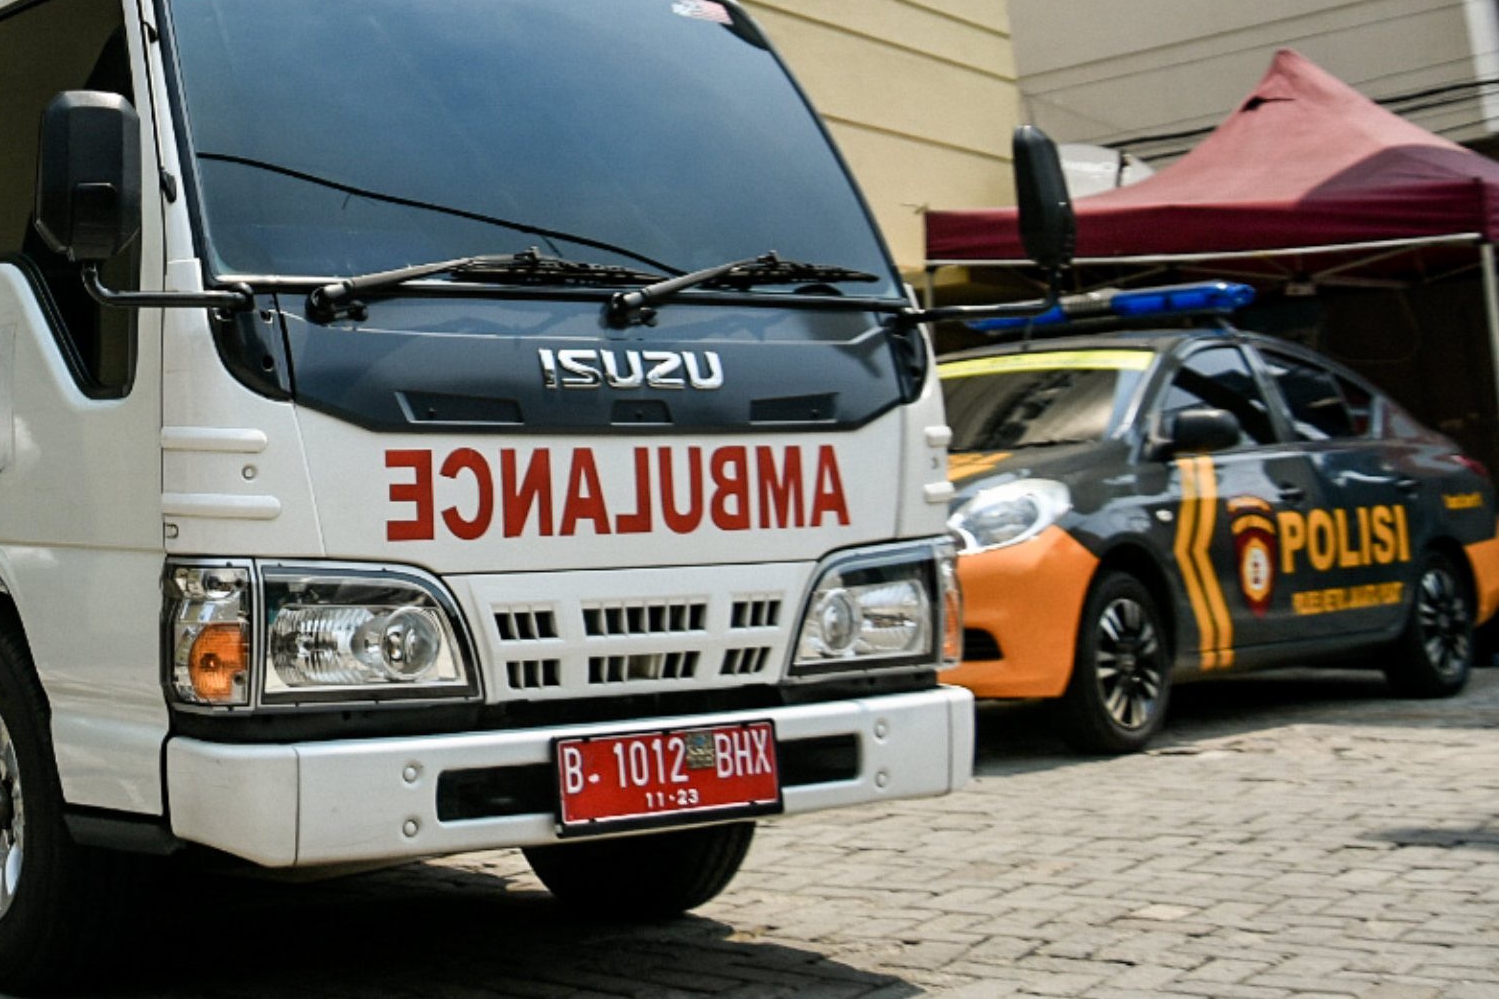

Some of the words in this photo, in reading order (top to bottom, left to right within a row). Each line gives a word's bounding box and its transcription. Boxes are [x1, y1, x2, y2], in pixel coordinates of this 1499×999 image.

[538, 348, 724, 389] ISUZU
[1277, 504, 1412, 574] POLISI
[613, 737, 689, 788] 1012
[715, 729, 772, 778] BHX
